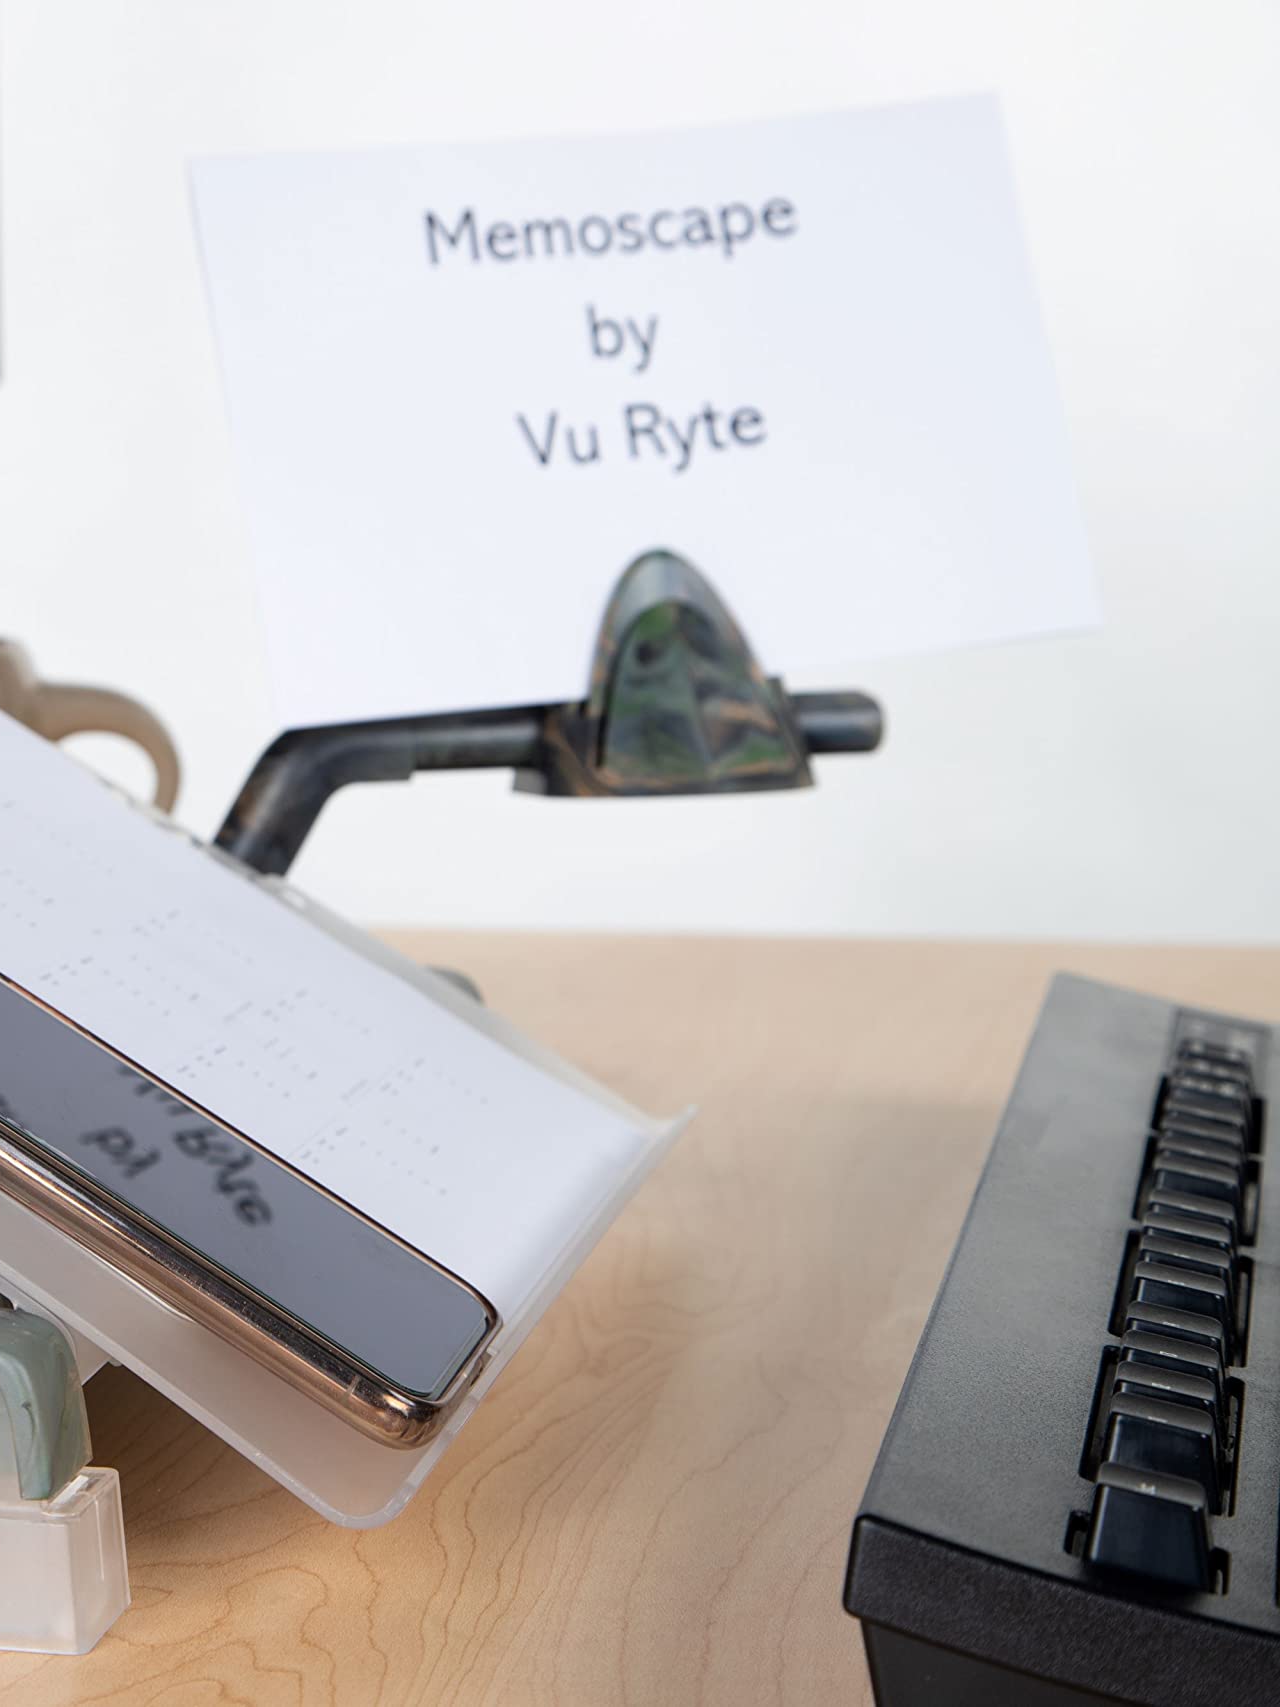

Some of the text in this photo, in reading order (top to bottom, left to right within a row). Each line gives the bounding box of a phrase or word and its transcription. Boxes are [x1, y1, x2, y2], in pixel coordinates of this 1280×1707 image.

[423, 198, 797, 266] Memoscape
[586, 304, 660, 373] by
[516, 402, 765, 473] Vu Ryte
